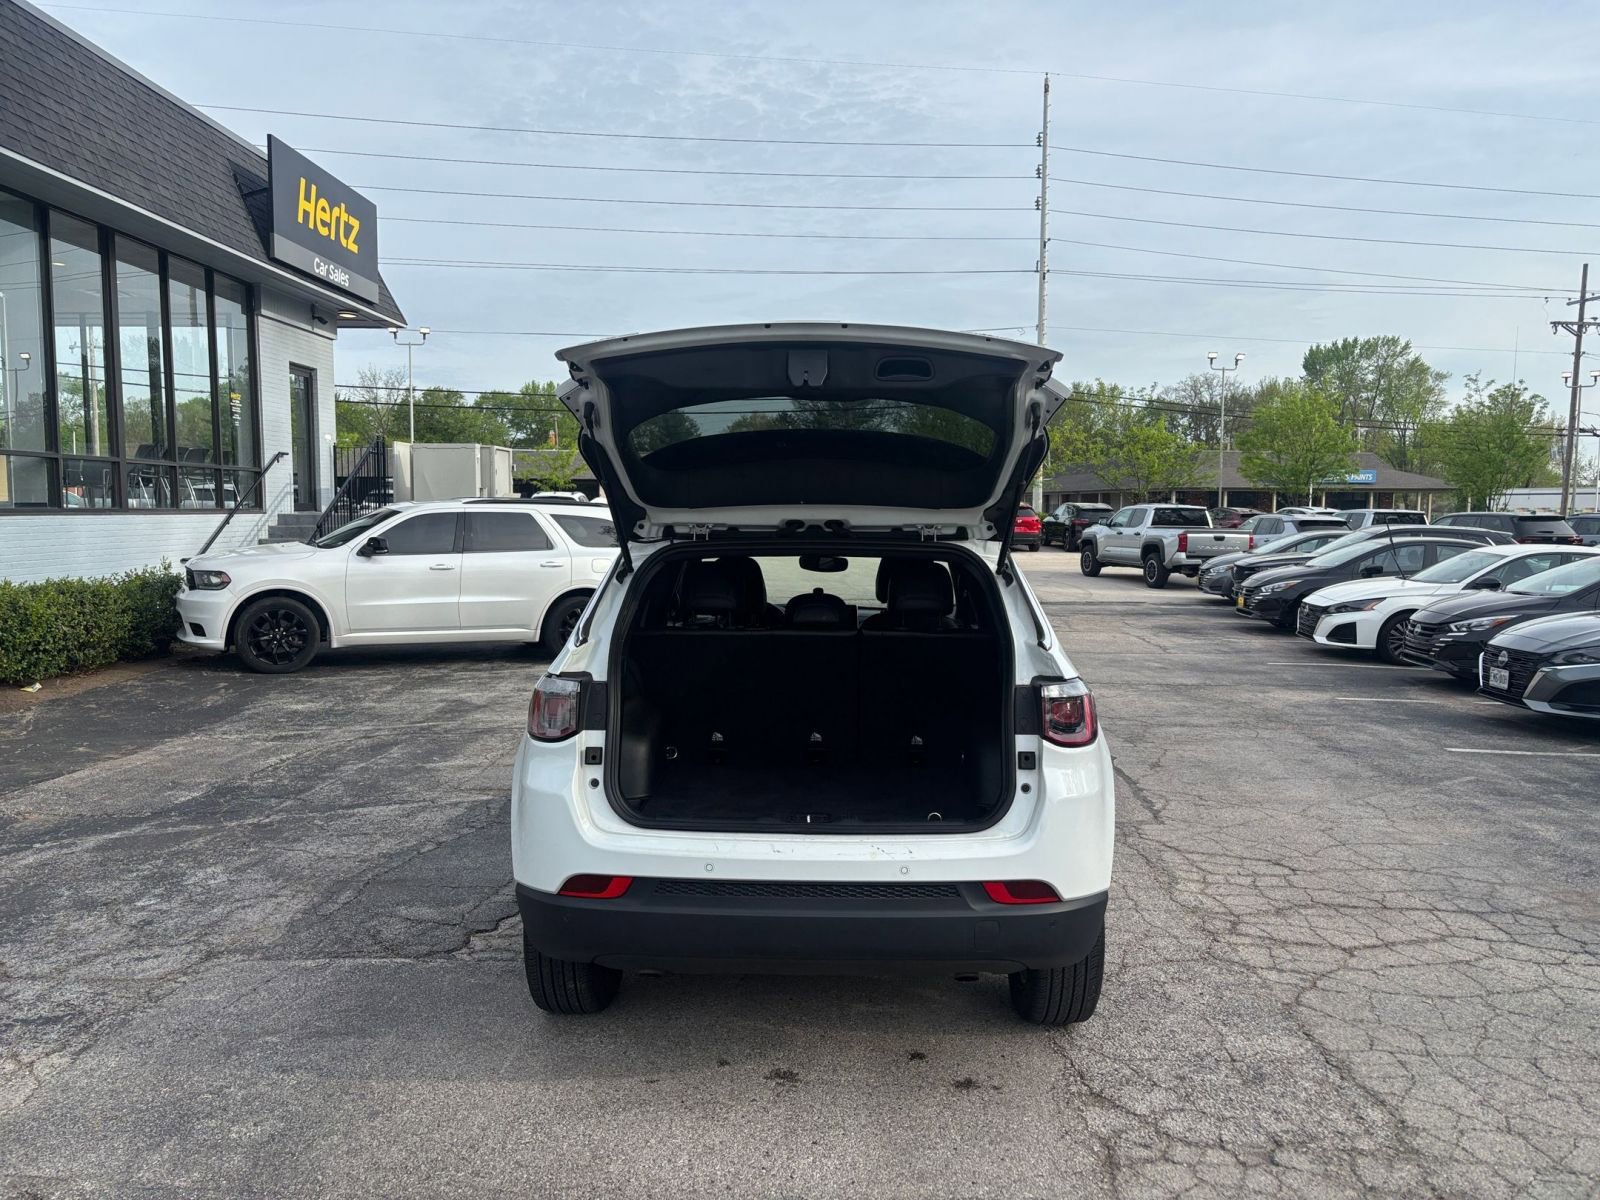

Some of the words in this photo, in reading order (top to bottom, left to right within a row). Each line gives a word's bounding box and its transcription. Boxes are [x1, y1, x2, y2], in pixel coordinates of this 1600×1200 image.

[297, 177, 361, 254] Hertz
[313, 257, 328, 277] Car
[328, 264, 350, 287] Sales
